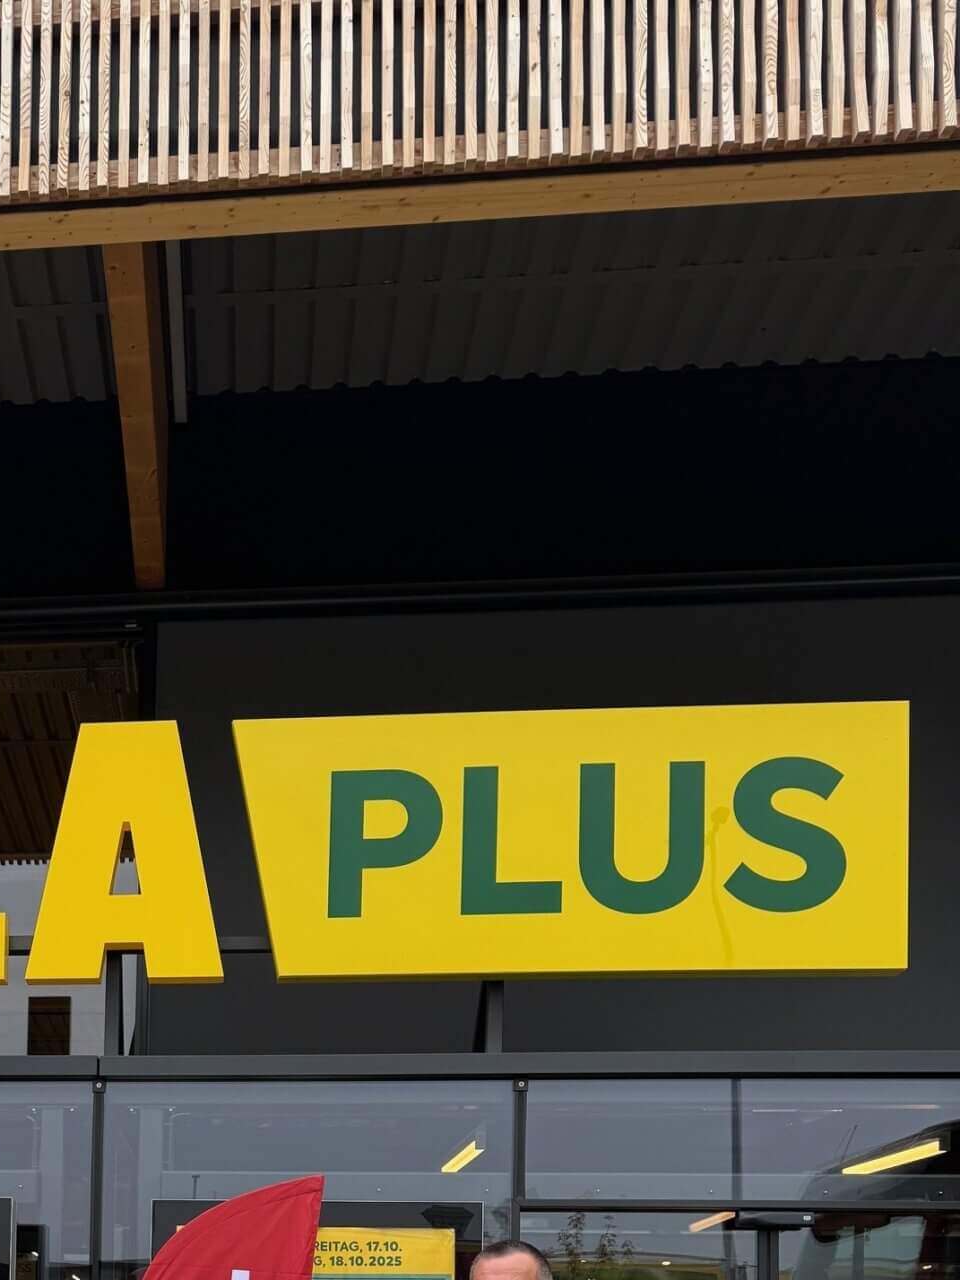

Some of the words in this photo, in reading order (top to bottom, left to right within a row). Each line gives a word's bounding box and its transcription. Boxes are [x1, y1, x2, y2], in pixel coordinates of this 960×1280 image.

[327, 756, 847, 919] PLUS
[366, 1241, 402, 1252] 17.10.
[330, 1255, 402, 1267] 18.10.2025
